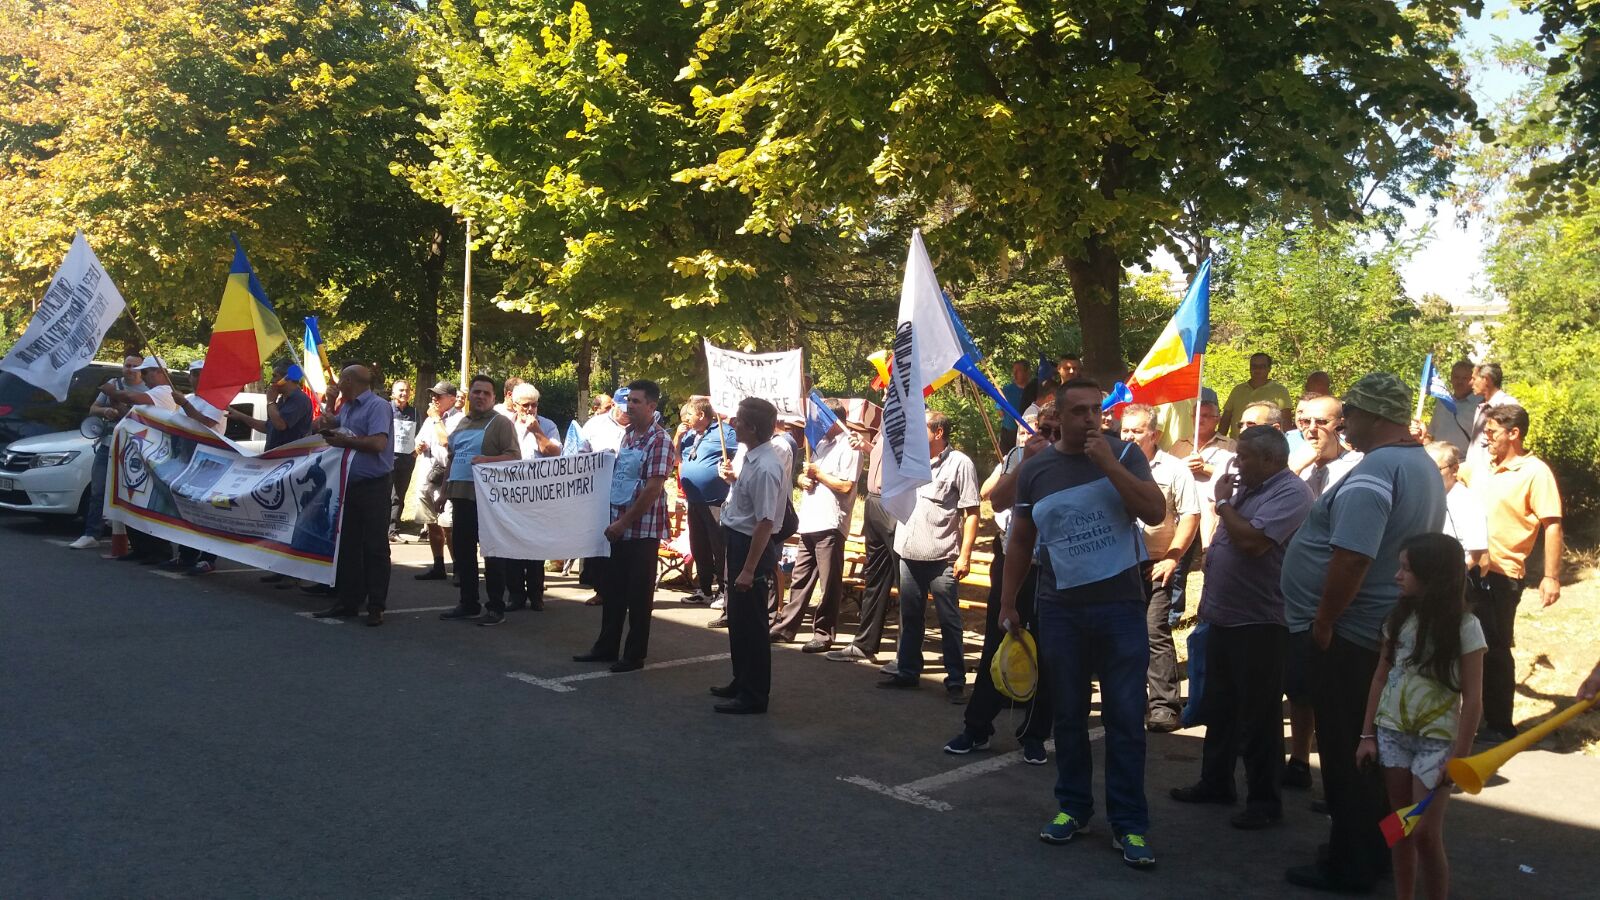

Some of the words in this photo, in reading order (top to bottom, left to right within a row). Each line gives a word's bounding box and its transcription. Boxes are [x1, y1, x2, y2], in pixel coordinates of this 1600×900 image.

[480, 462, 525, 483] SALARII
[502, 483, 565, 504] RASPUNDERI
[567, 475, 594, 498] MARI
[1075, 510, 1105, 527] CNSLR
[1069, 536, 1117, 557] CONSTANTA
